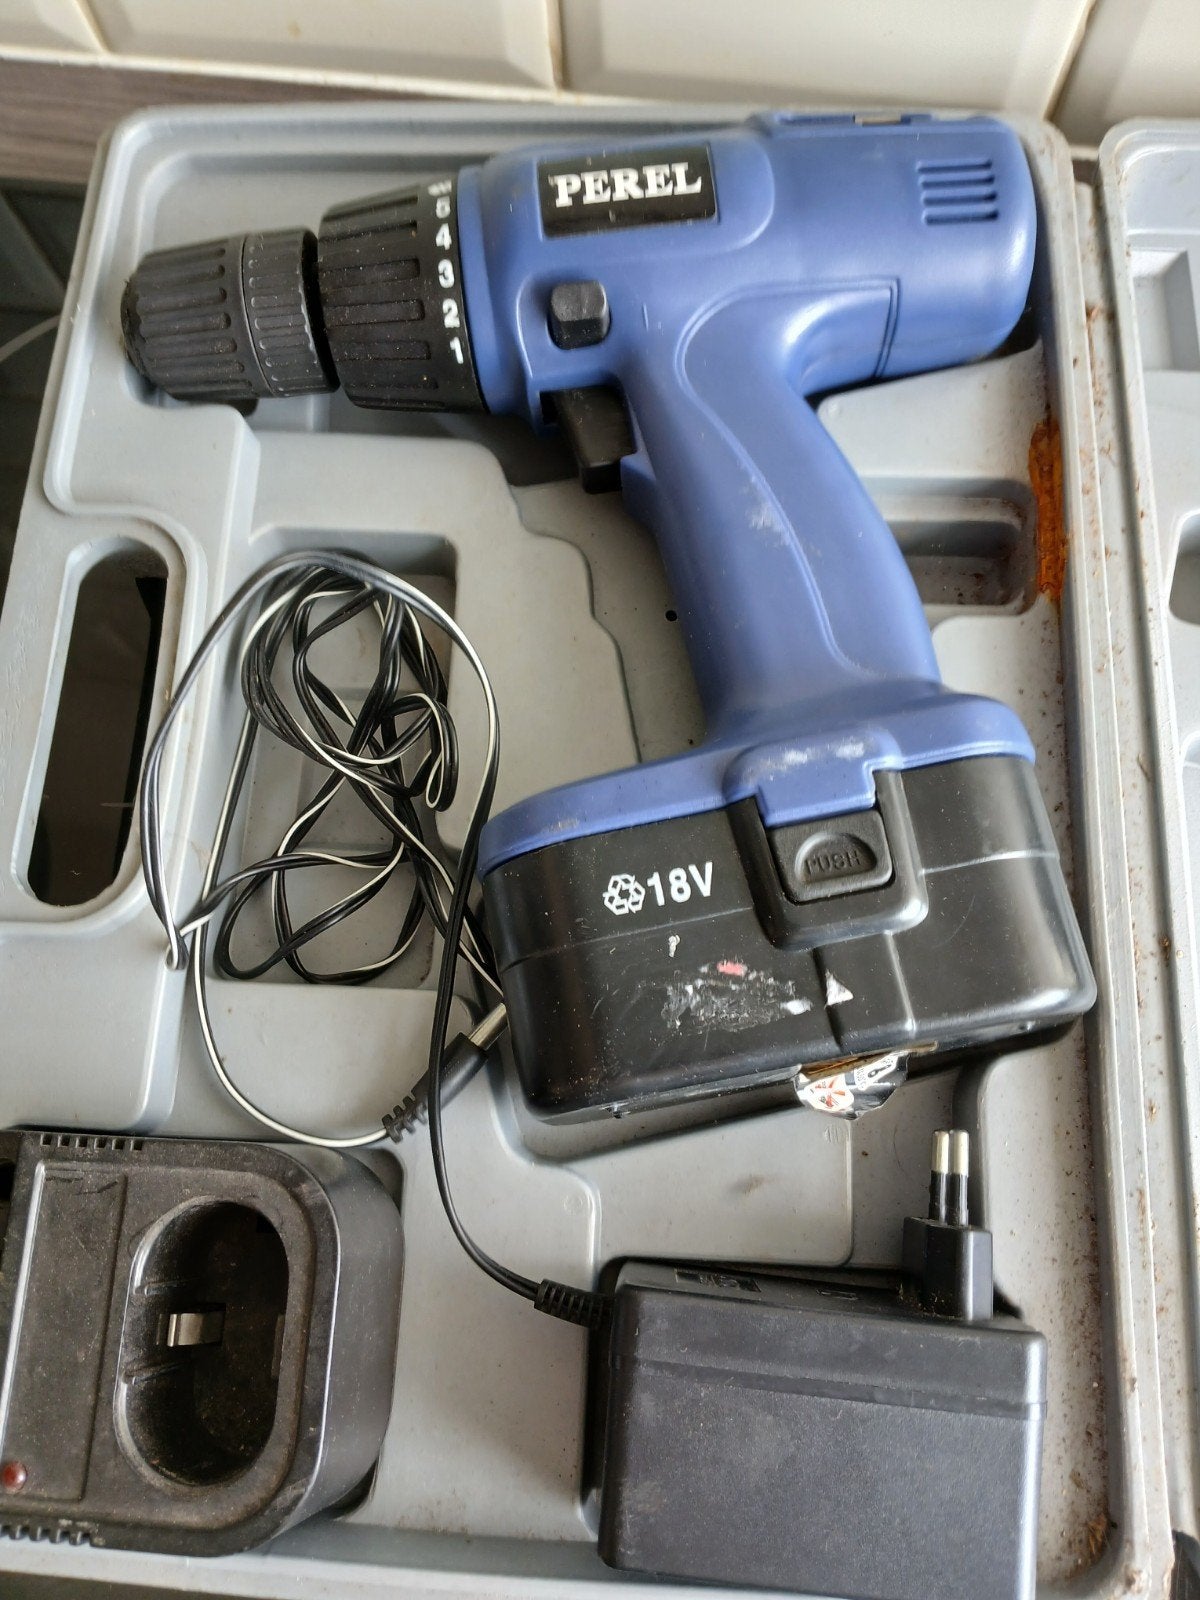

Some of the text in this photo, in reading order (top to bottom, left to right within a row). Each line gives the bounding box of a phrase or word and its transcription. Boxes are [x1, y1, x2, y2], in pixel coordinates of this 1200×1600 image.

[549, 162, 702, 208] PEREL
[435, 222, 452, 250] 4
[437, 259, 455, 289] 3
[442, 299, 460, 329] 2
[449, 336, 464, 365] 1
[804, 849, 861, 875] PUSH
[647, 861, 714, 907] 18V
